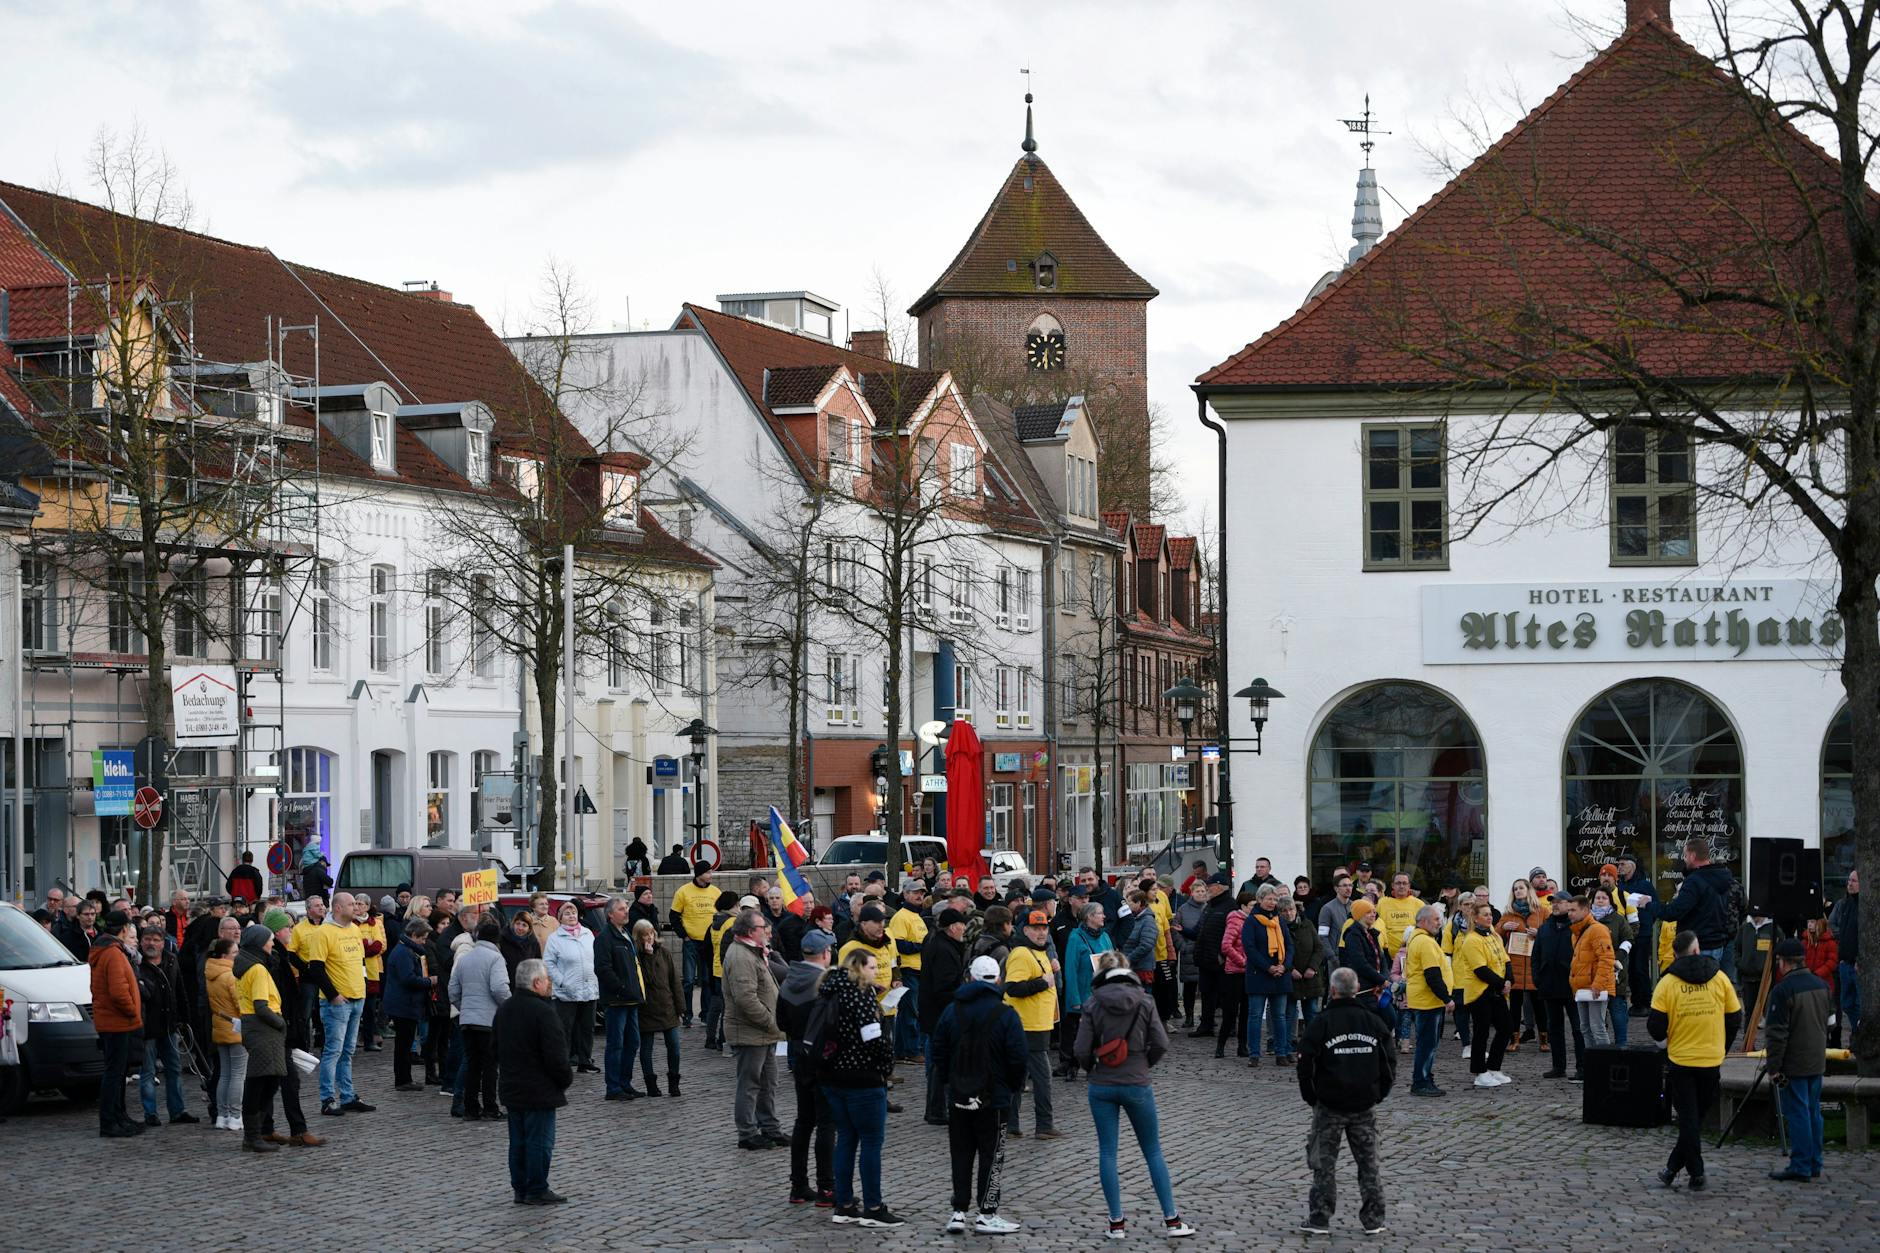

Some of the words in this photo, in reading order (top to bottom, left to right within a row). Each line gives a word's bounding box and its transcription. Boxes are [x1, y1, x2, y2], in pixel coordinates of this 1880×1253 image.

[1529, 588, 1604, 604] HOTEL
[1623, 586, 1774, 603] RESTAURANT
[1460, 611, 1598, 650] Altes
[1625, 608, 1845, 658] Rathaus
[104, 760, 127, 776] klein
[180, 794, 200, 803] HABEN
[186, 804, 200, 816] SIE
[464, 873, 482, 889] WIR
[469, 889, 493, 904] NEIN
[1680, 984, 1709, 995] Upahl
[1324, 1034, 1347, 1049] MARIO
